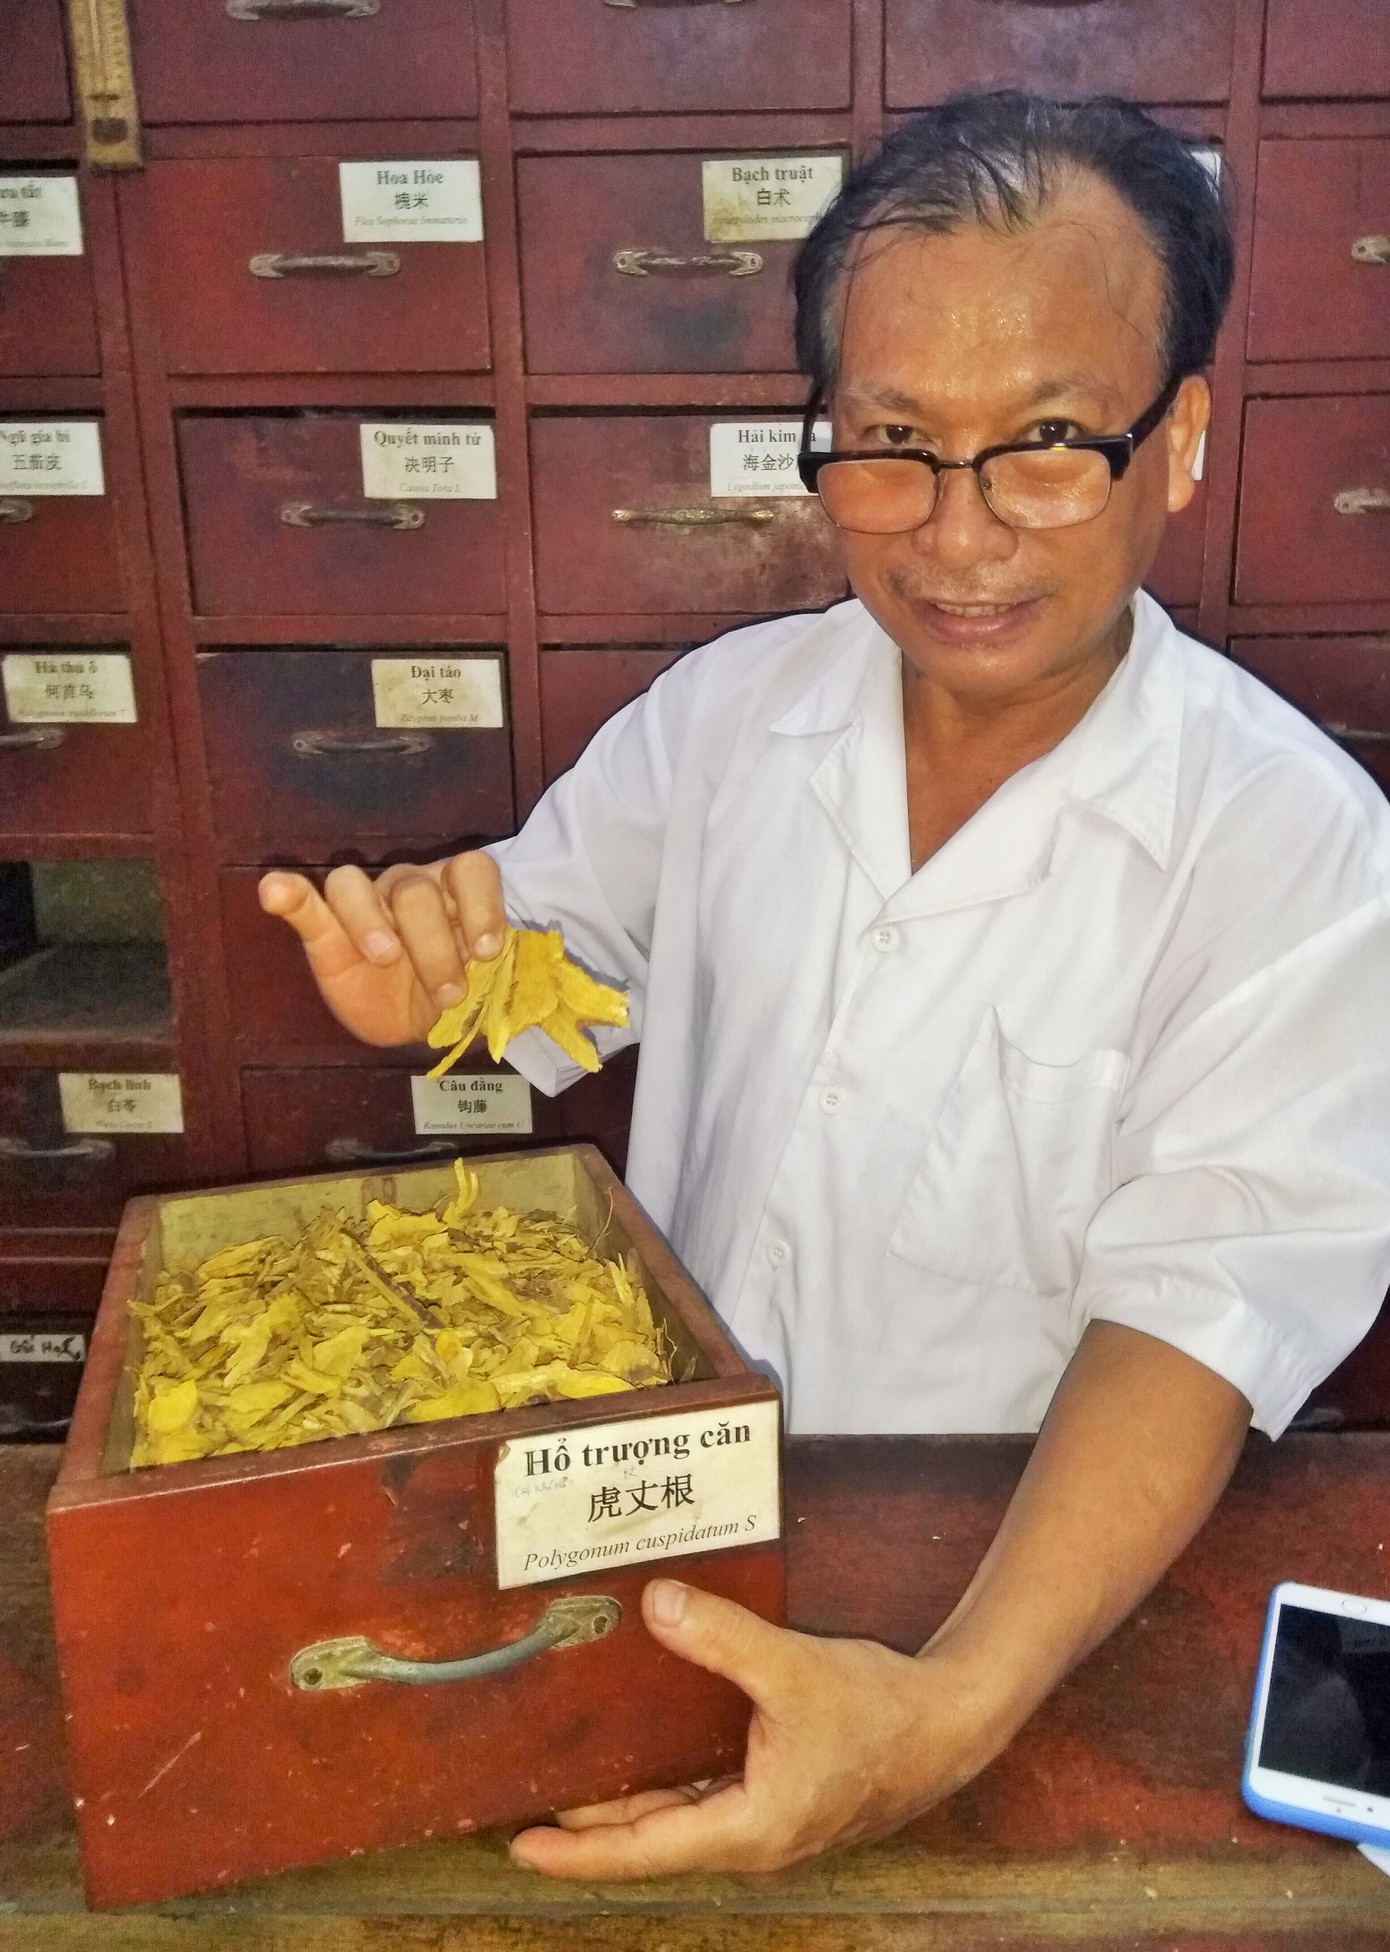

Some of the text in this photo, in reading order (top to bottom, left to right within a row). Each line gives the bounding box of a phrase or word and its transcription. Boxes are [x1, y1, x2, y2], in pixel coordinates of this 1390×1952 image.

[377, 168, 444, 185] Hoa Hòe
[731, 166, 769, 185] Bạch
[374, 428, 419, 448] Quyết
[738, 429, 764, 443] Hải
[769, 429, 797, 443] kim
[743, 453, 799, 471] 海金沙
[411, 665, 461, 681] Đại táo
[422, 688, 454, 705] 大枣
[439, 1080, 466, 1092] Câu
[523, 1421, 751, 1477] Hổ trượng căn
[587, 1473, 695, 1523] 虎丈根
[523, 1514, 757, 1571] Polygonum cuspidatum S
